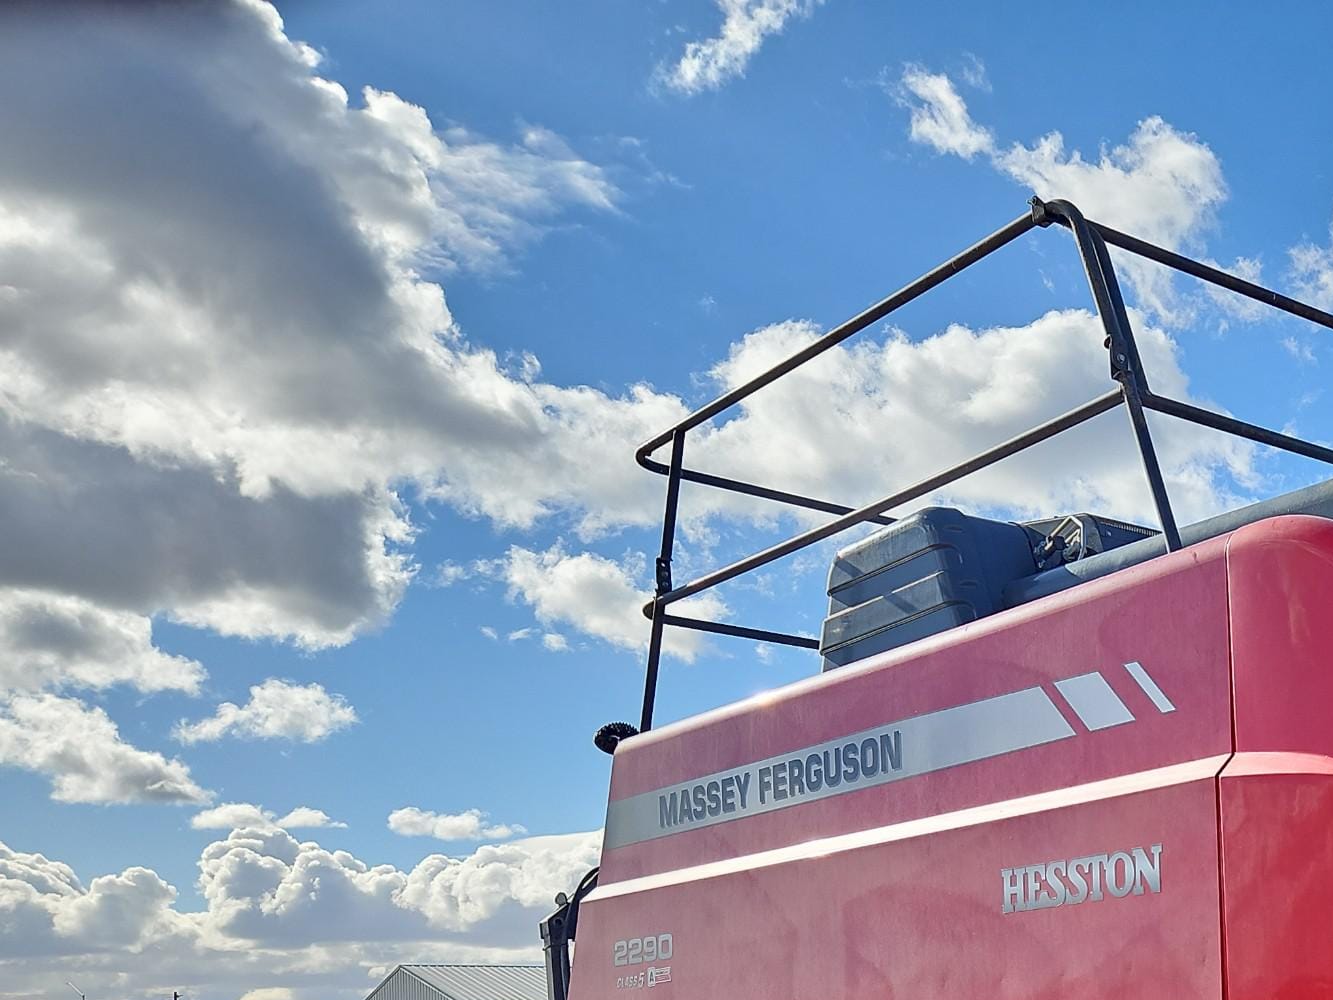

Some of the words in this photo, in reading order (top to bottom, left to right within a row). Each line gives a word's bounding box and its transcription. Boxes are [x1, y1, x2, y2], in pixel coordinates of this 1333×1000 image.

[658, 772, 751, 829] MASSEY
[758, 731, 902, 805] FERGUSON
[1001, 843, 1163, 915] HESSTON
[613, 933, 673, 967] 2290
[616, 975, 638, 989] CLASS
